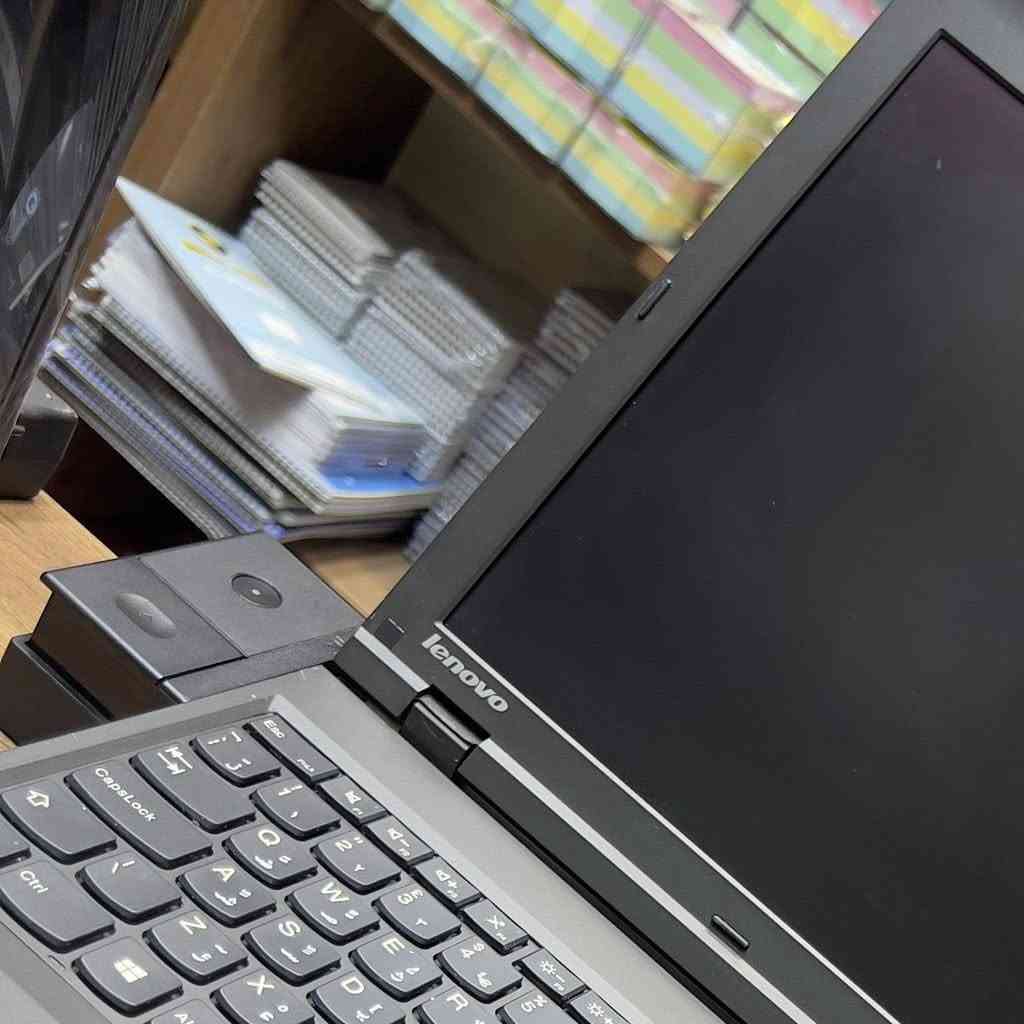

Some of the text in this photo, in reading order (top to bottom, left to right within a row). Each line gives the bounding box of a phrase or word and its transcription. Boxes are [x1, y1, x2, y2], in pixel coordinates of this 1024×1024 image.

[419, 631, 511, 714] lenovo
[263, 717, 287, 739] Esc
[95, 767, 156, 824] CapsLock
[257, 828, 281, 847] Q
[334, 839, 352, 852] 2
[19, 870, 49, 894] Ctrl
[211, 867, 236, 883] A
[320, 881, 350, 903] W
[397, 892, 413, 905] 3
[178, 917, 207, 935] Z
[278, 920, 301, 937] S
[381, 937, 405, 955] E
[460, 946, 475, 959] 4
[246, 974, 275, 996] X
[340, 975, 365, 994] D
[445, 990, 469, 1012] R
[520, 1000, 537, 1013] 5
